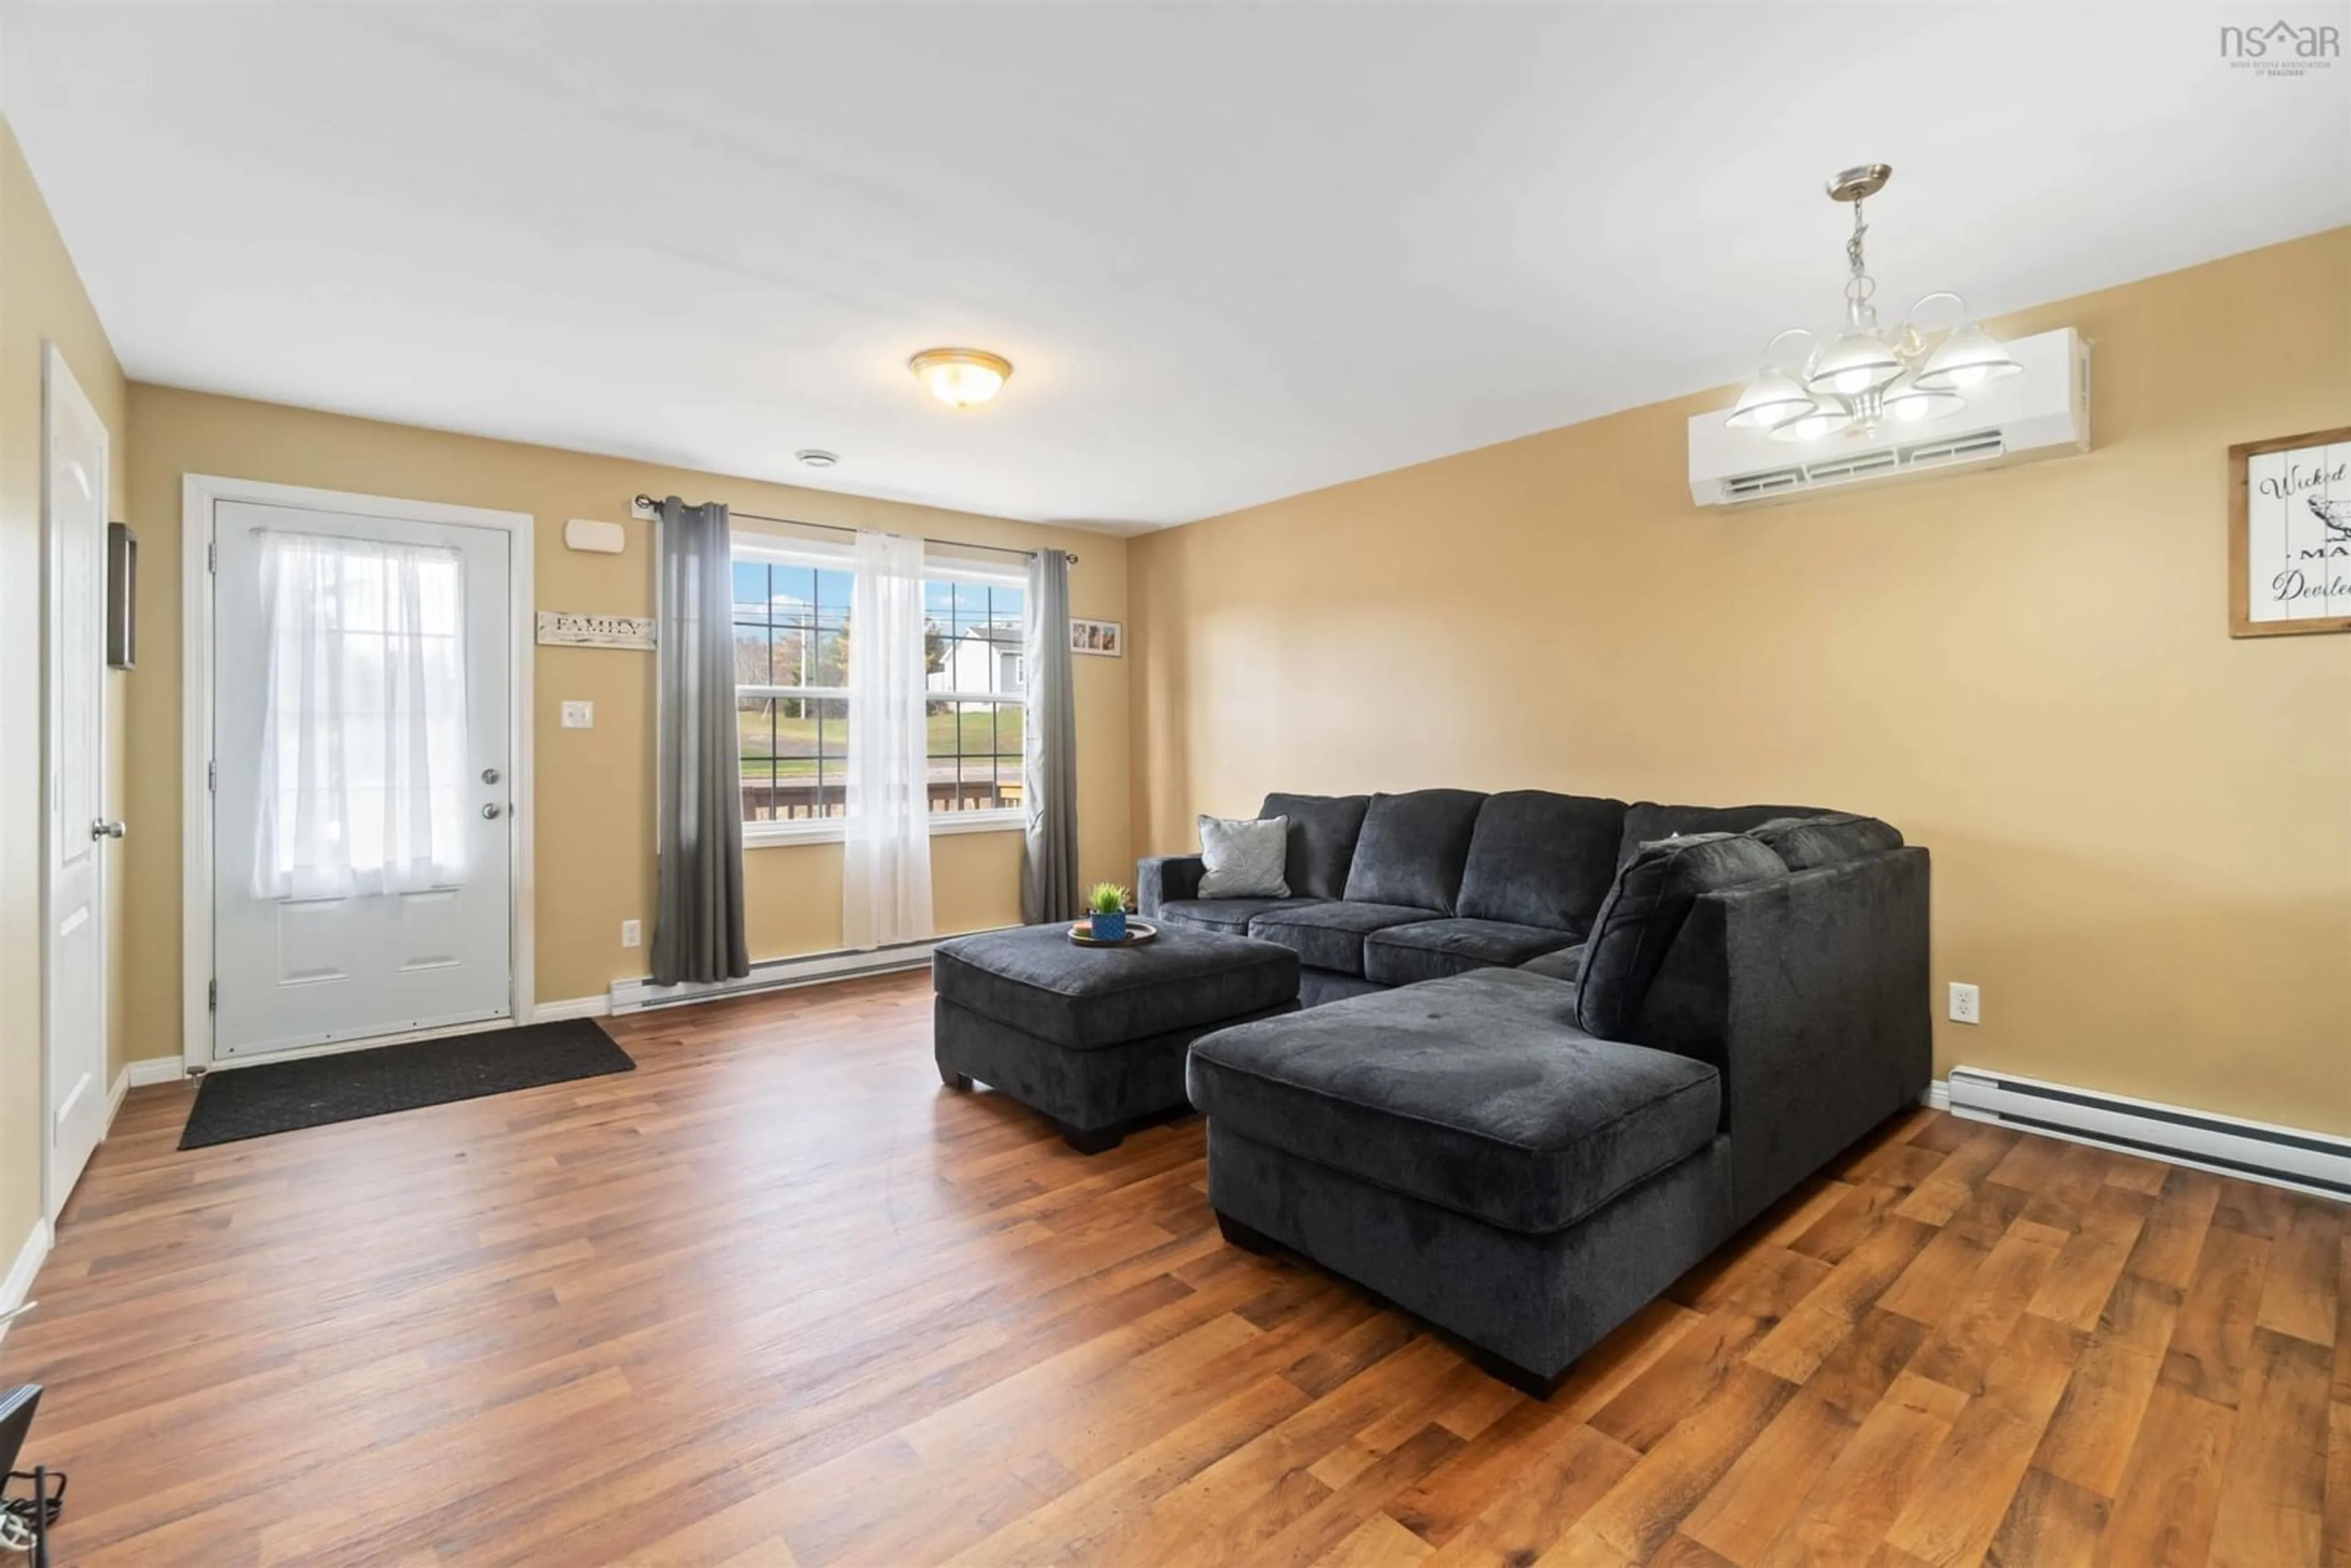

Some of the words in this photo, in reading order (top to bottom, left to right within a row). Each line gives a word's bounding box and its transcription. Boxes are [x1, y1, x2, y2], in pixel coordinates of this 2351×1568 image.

[2260, 464, 2345, 499] Wicked
[2300, 547, 2349, 560] MA
[2272, 568, 2351, 601] Devile
[557, 617, 641, 634] FAMILY
